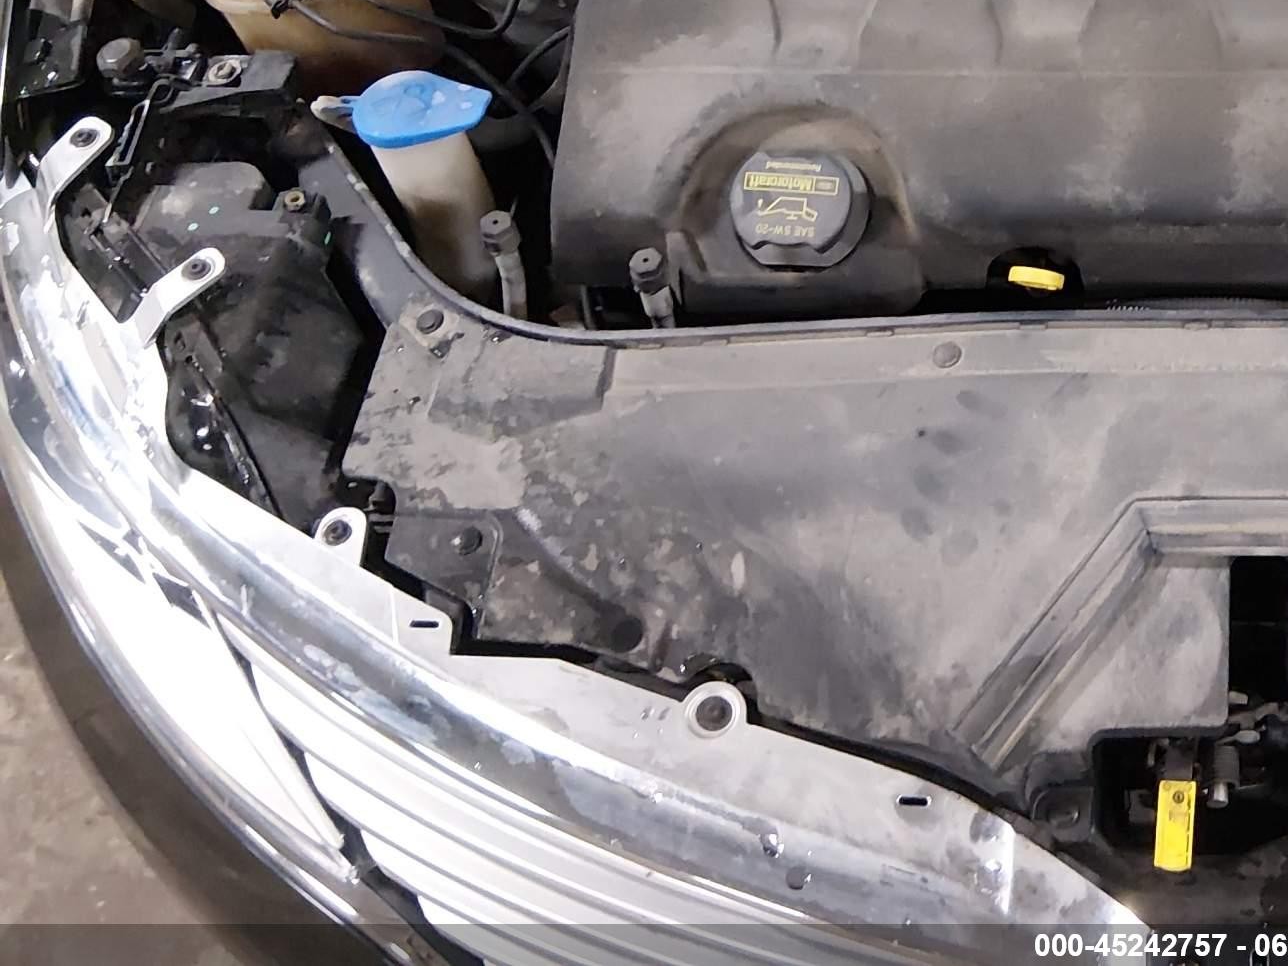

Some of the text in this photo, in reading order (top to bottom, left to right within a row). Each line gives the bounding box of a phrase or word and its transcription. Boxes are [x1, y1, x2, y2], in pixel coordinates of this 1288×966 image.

[749, 175, 813, 191] Motorcraft
[755, 223, 815, 237] SAE 5W-20
